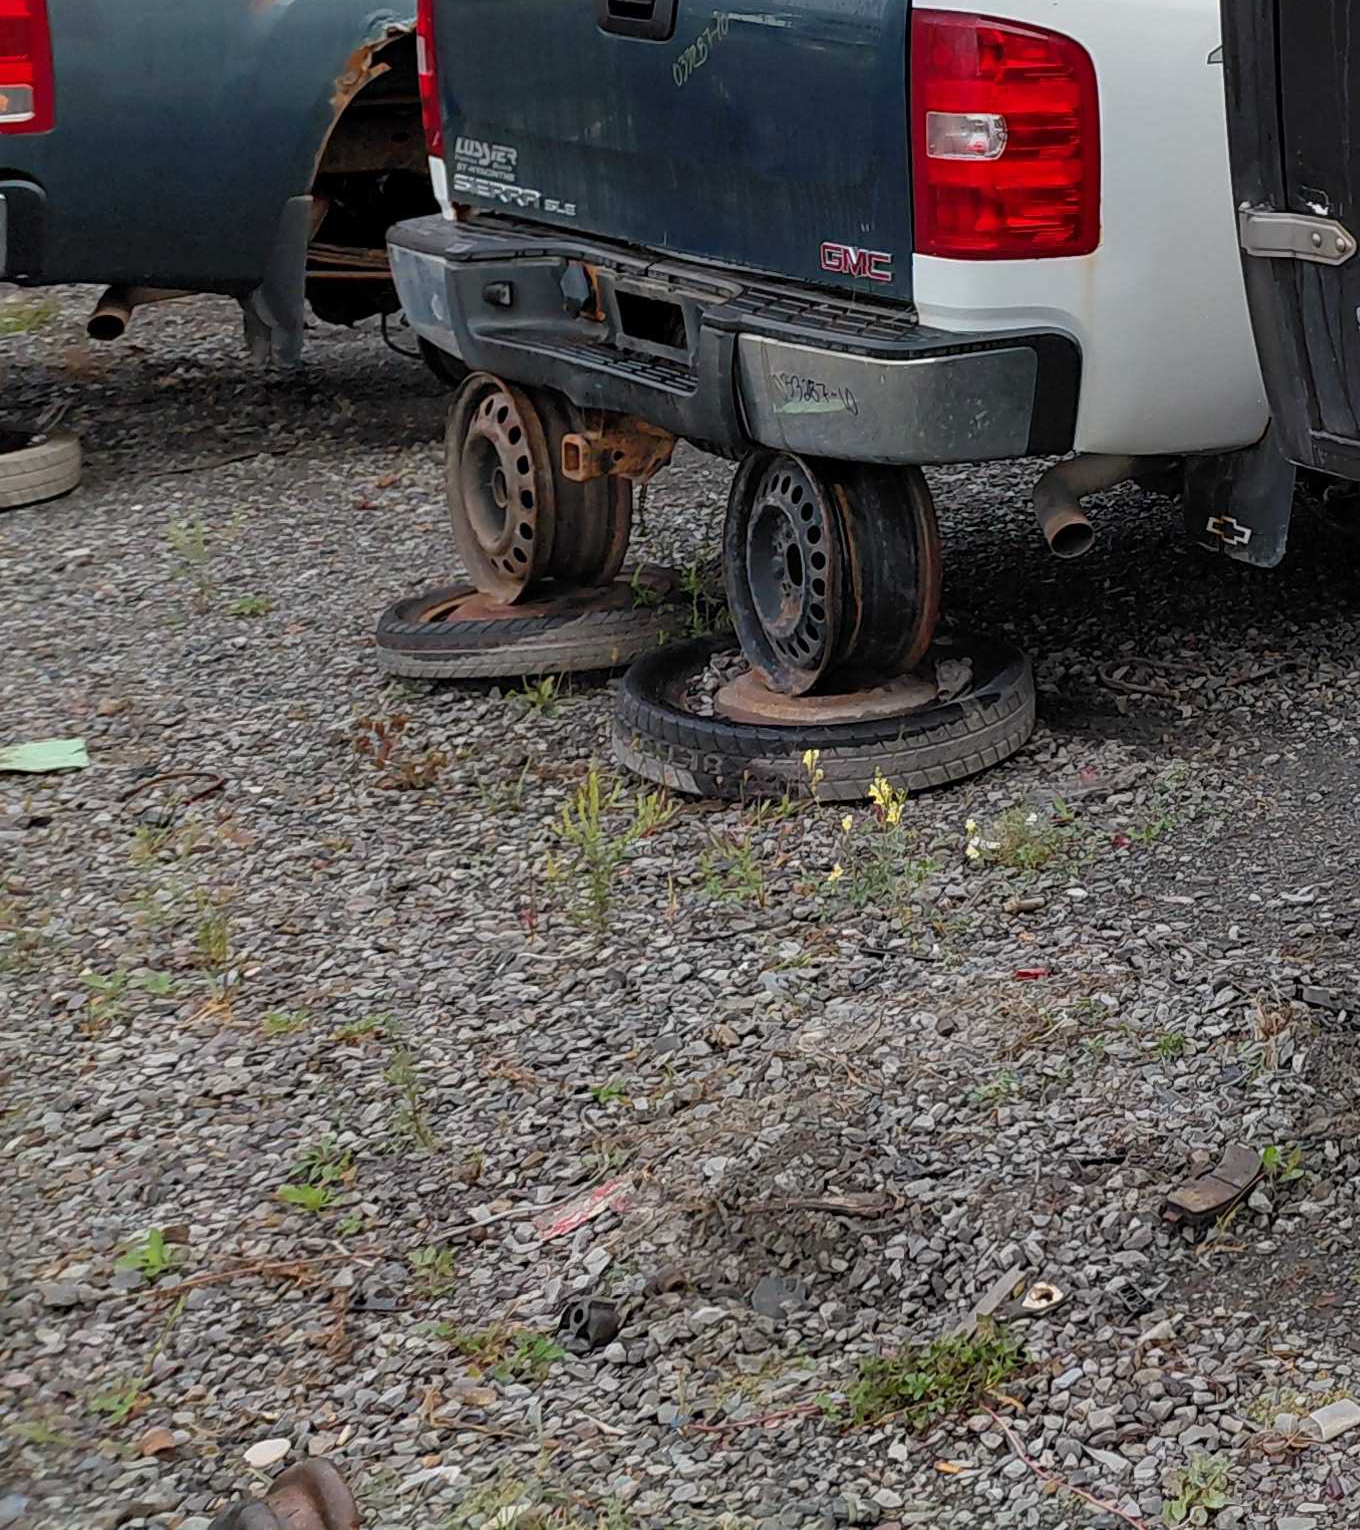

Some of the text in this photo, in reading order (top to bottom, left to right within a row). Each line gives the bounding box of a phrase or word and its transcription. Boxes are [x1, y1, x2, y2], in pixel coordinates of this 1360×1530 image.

[453, 173, 577, 217] SIERRA SLE
[820, 241, 893, 282] GMC
